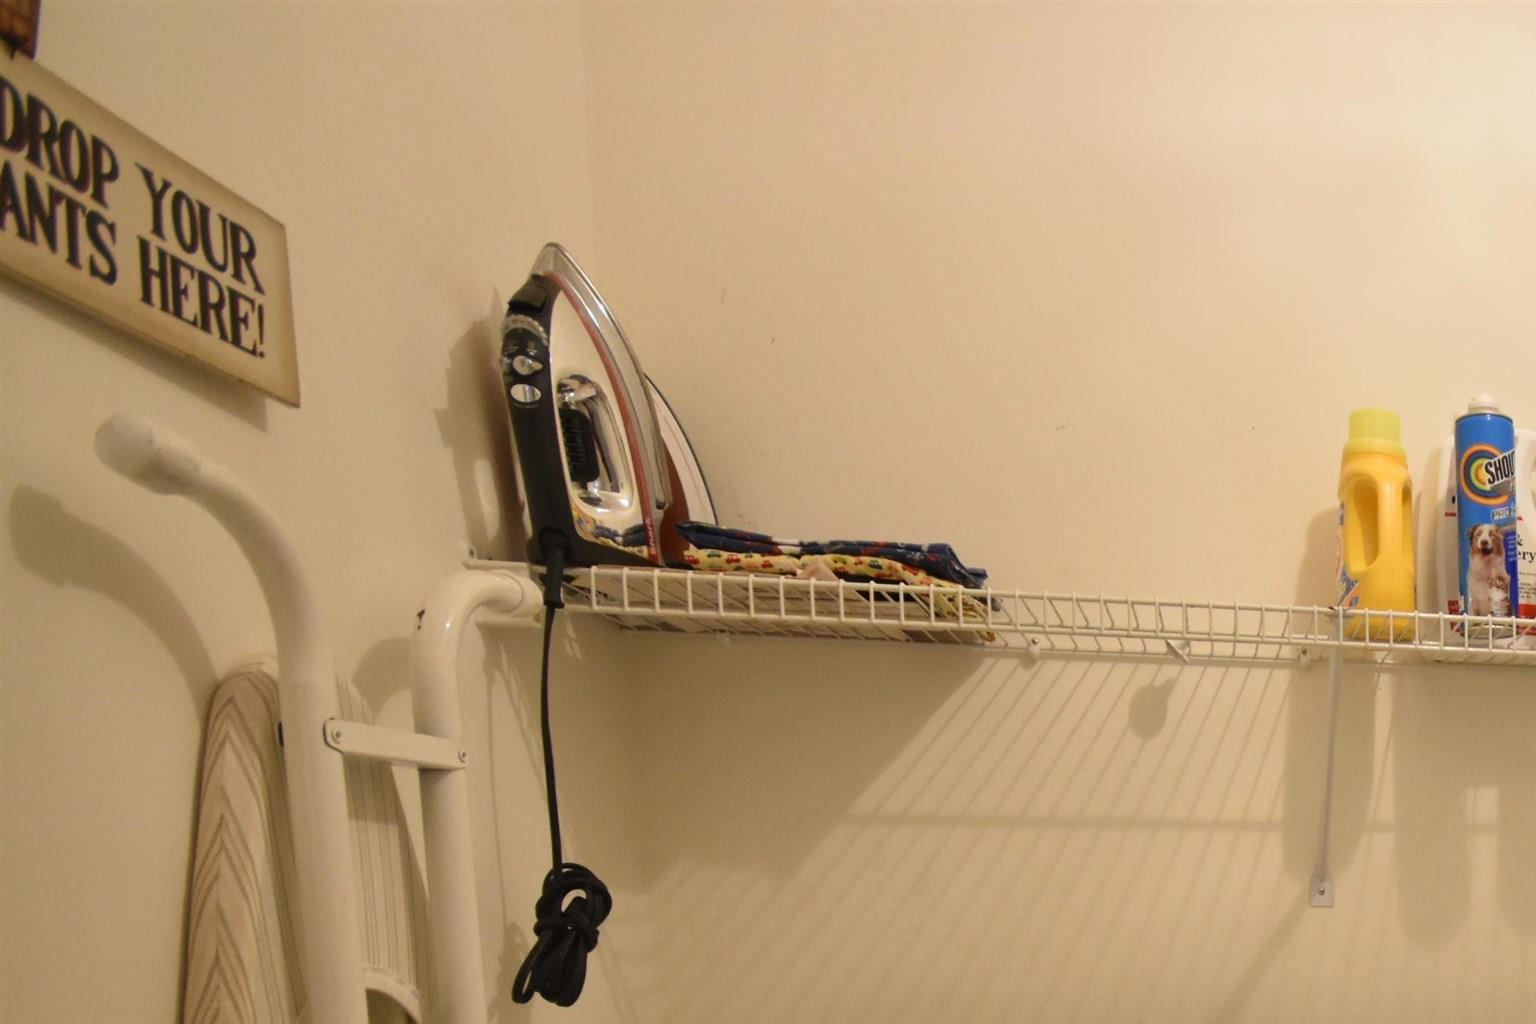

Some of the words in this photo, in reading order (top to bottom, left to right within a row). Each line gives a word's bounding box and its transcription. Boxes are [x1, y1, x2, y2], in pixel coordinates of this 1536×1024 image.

[0, 76, 119, 209] DROP
[135, 162, 265, 295] YOUR
[0, 159, 118, 285] ANTS
[137, 235, 265, 358] HERE!
